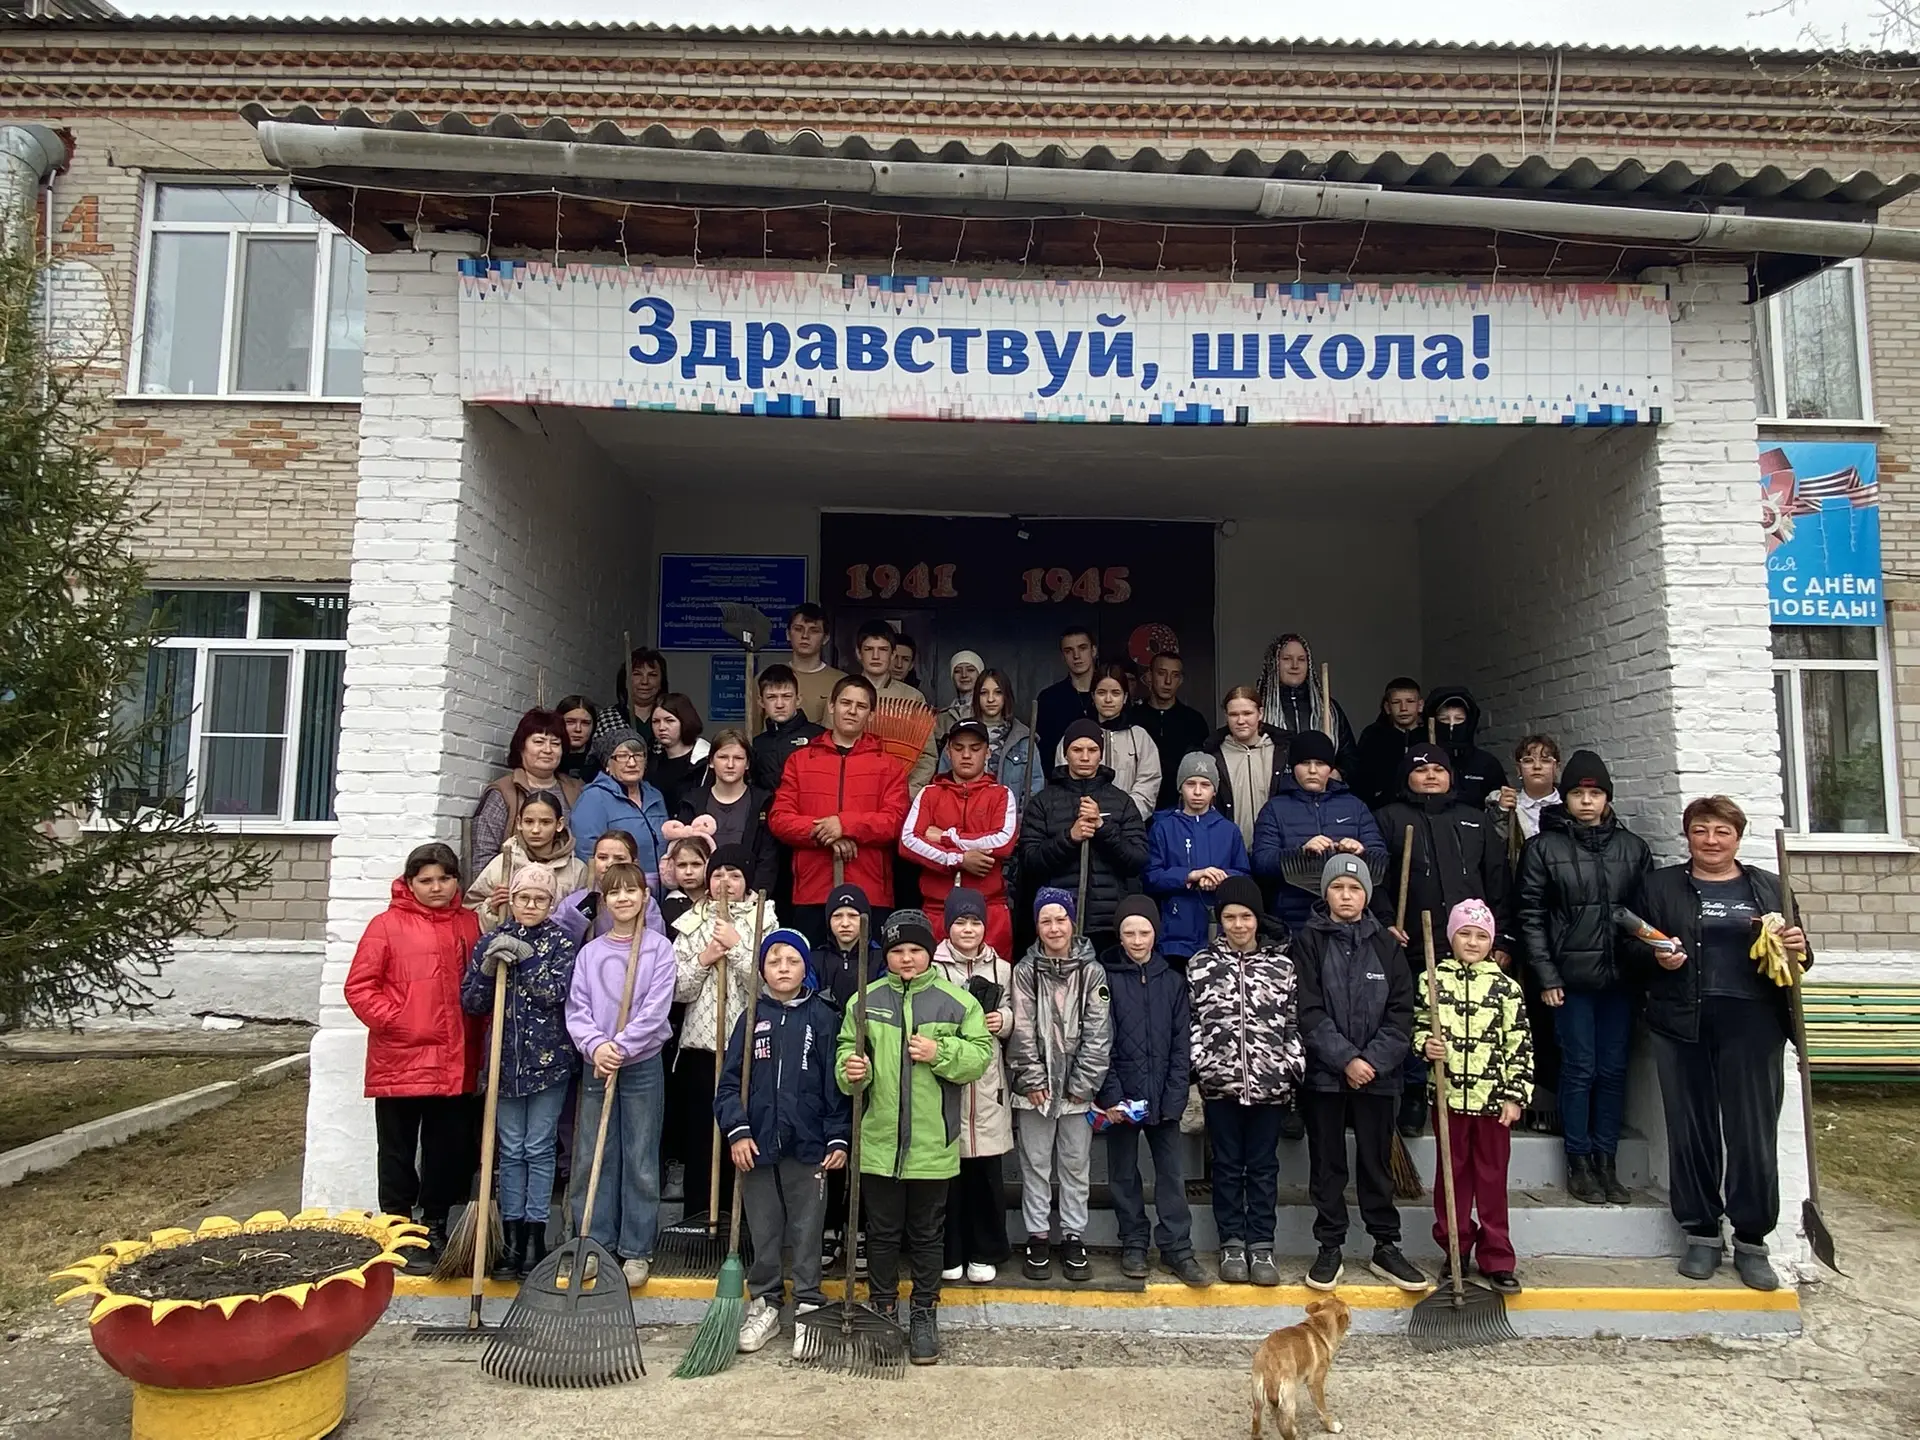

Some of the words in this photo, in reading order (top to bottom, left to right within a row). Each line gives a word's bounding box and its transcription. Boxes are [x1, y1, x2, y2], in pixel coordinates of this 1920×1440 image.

[628, 297, 1159, 397] Здравствуй,
[1192, 314, 1491, 380] школа!
[846, 561, 958, 600] 1941
[1021, 566, 1132, 604] 1945
[1782, 576, 1798, 594] С
[1804, 574, 1876, 597] ДНЁМ
[1769, 599, 1877, 619] ПОБЕДЫ!
